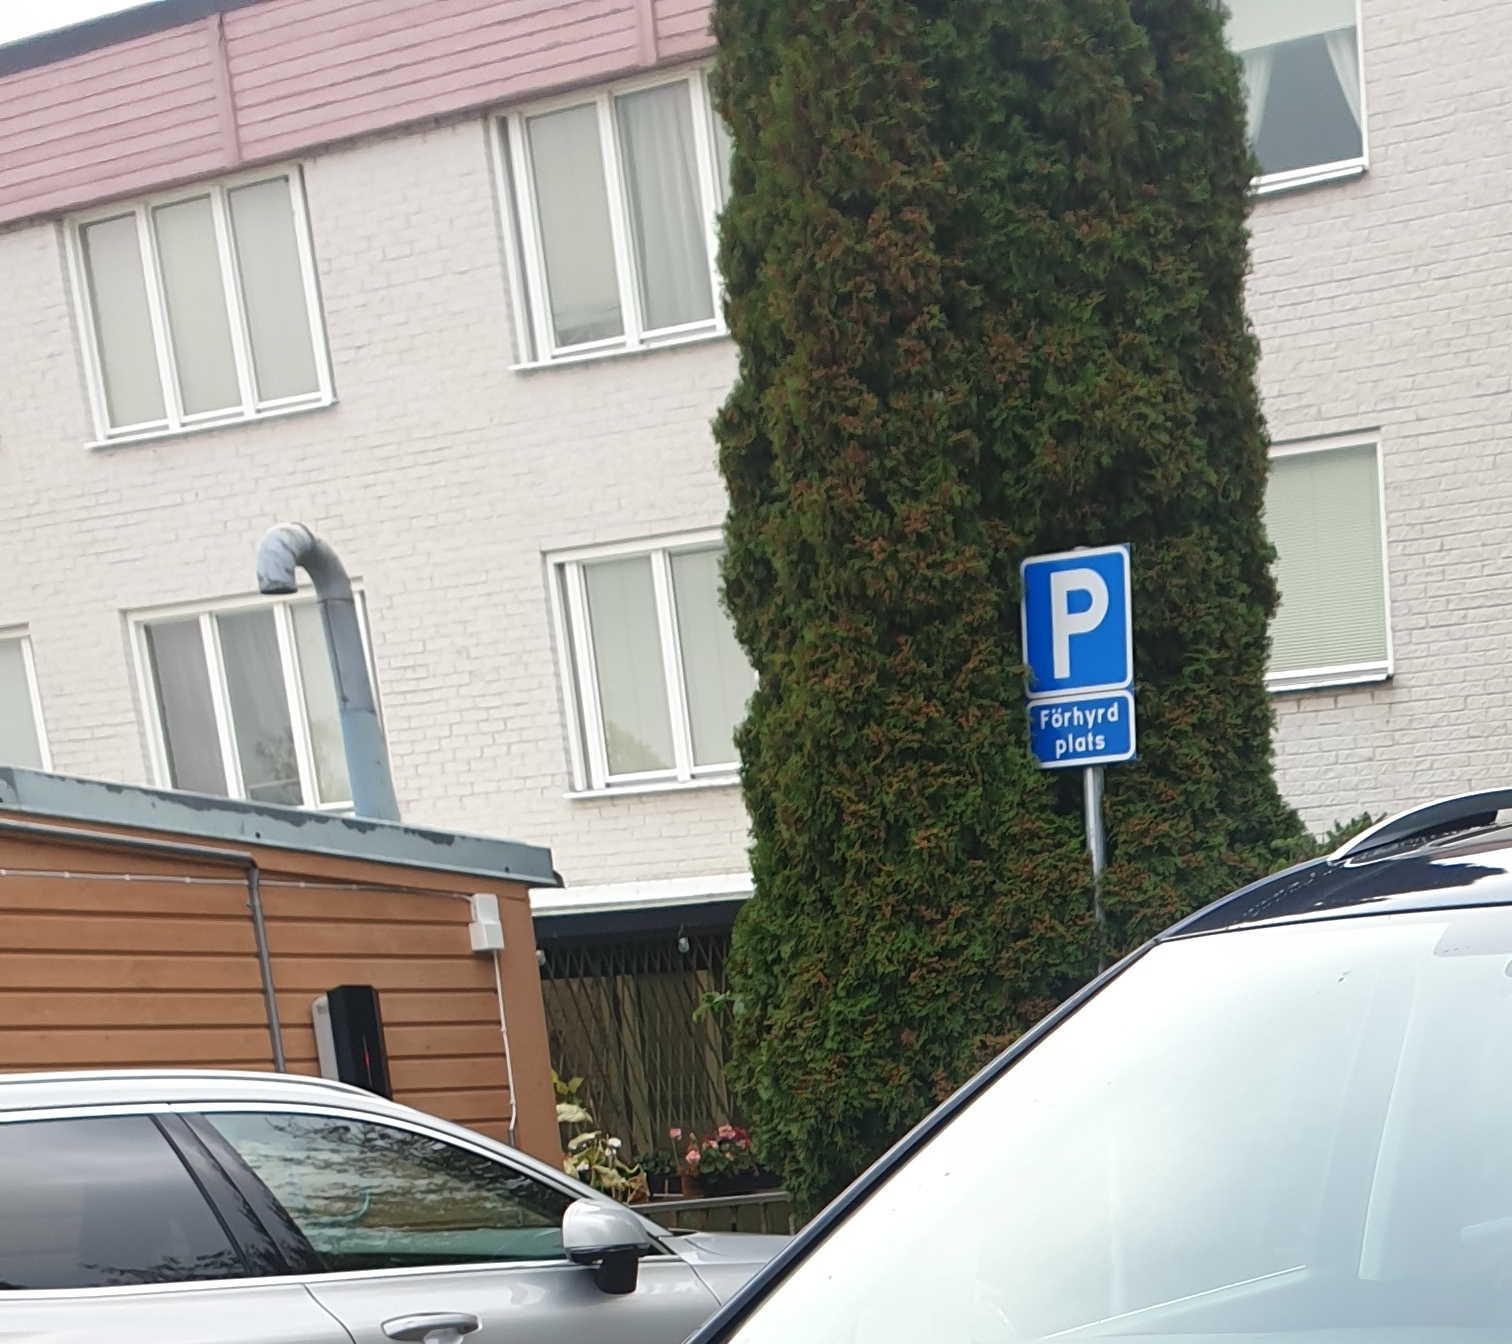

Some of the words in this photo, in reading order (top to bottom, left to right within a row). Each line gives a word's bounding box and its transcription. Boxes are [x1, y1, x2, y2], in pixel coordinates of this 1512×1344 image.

[1050, 567, 1109, 680] P
[1039, 701, 1119, 730] Förhyrd
[1055, 732, 1106, 759] plats
